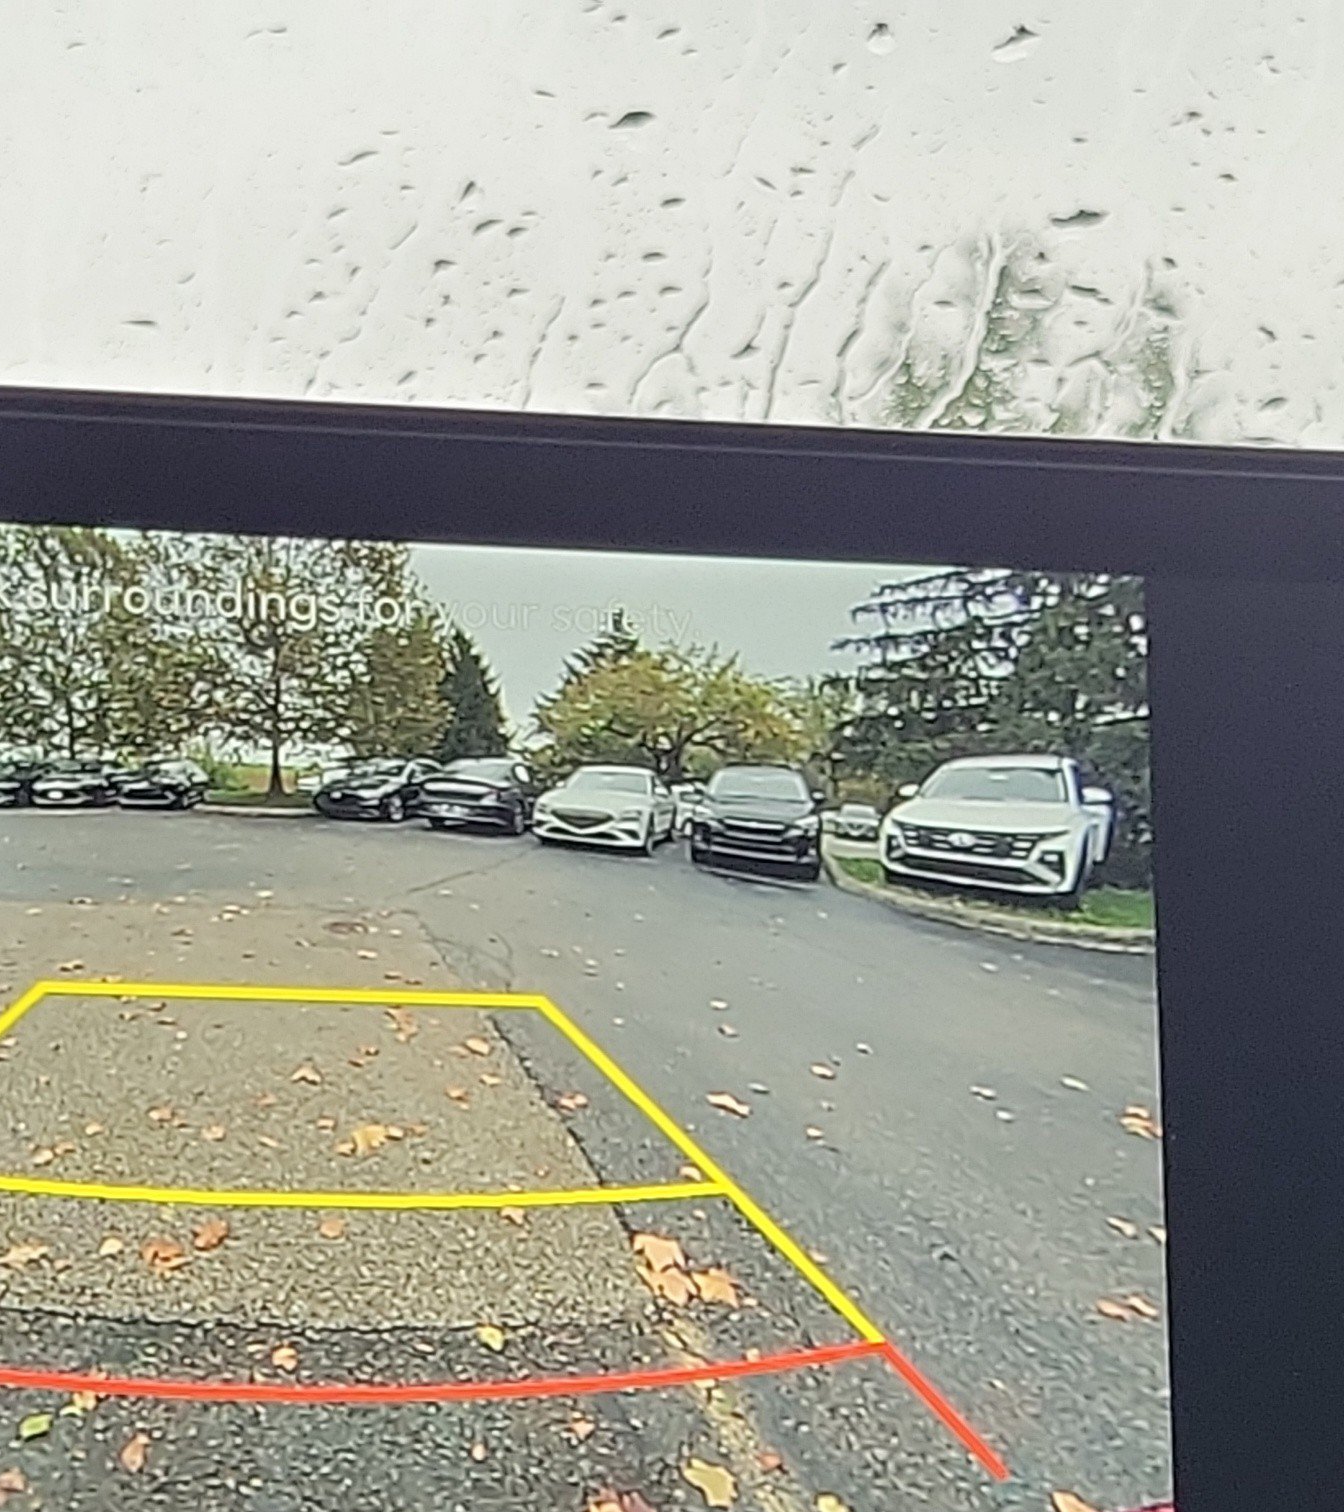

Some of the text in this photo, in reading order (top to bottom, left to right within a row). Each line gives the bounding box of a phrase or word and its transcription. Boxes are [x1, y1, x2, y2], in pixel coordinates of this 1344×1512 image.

[27, 581, 341, 631] surroundings
[357, 587, 422, 625] for
[438, 600, 540, 637] your
